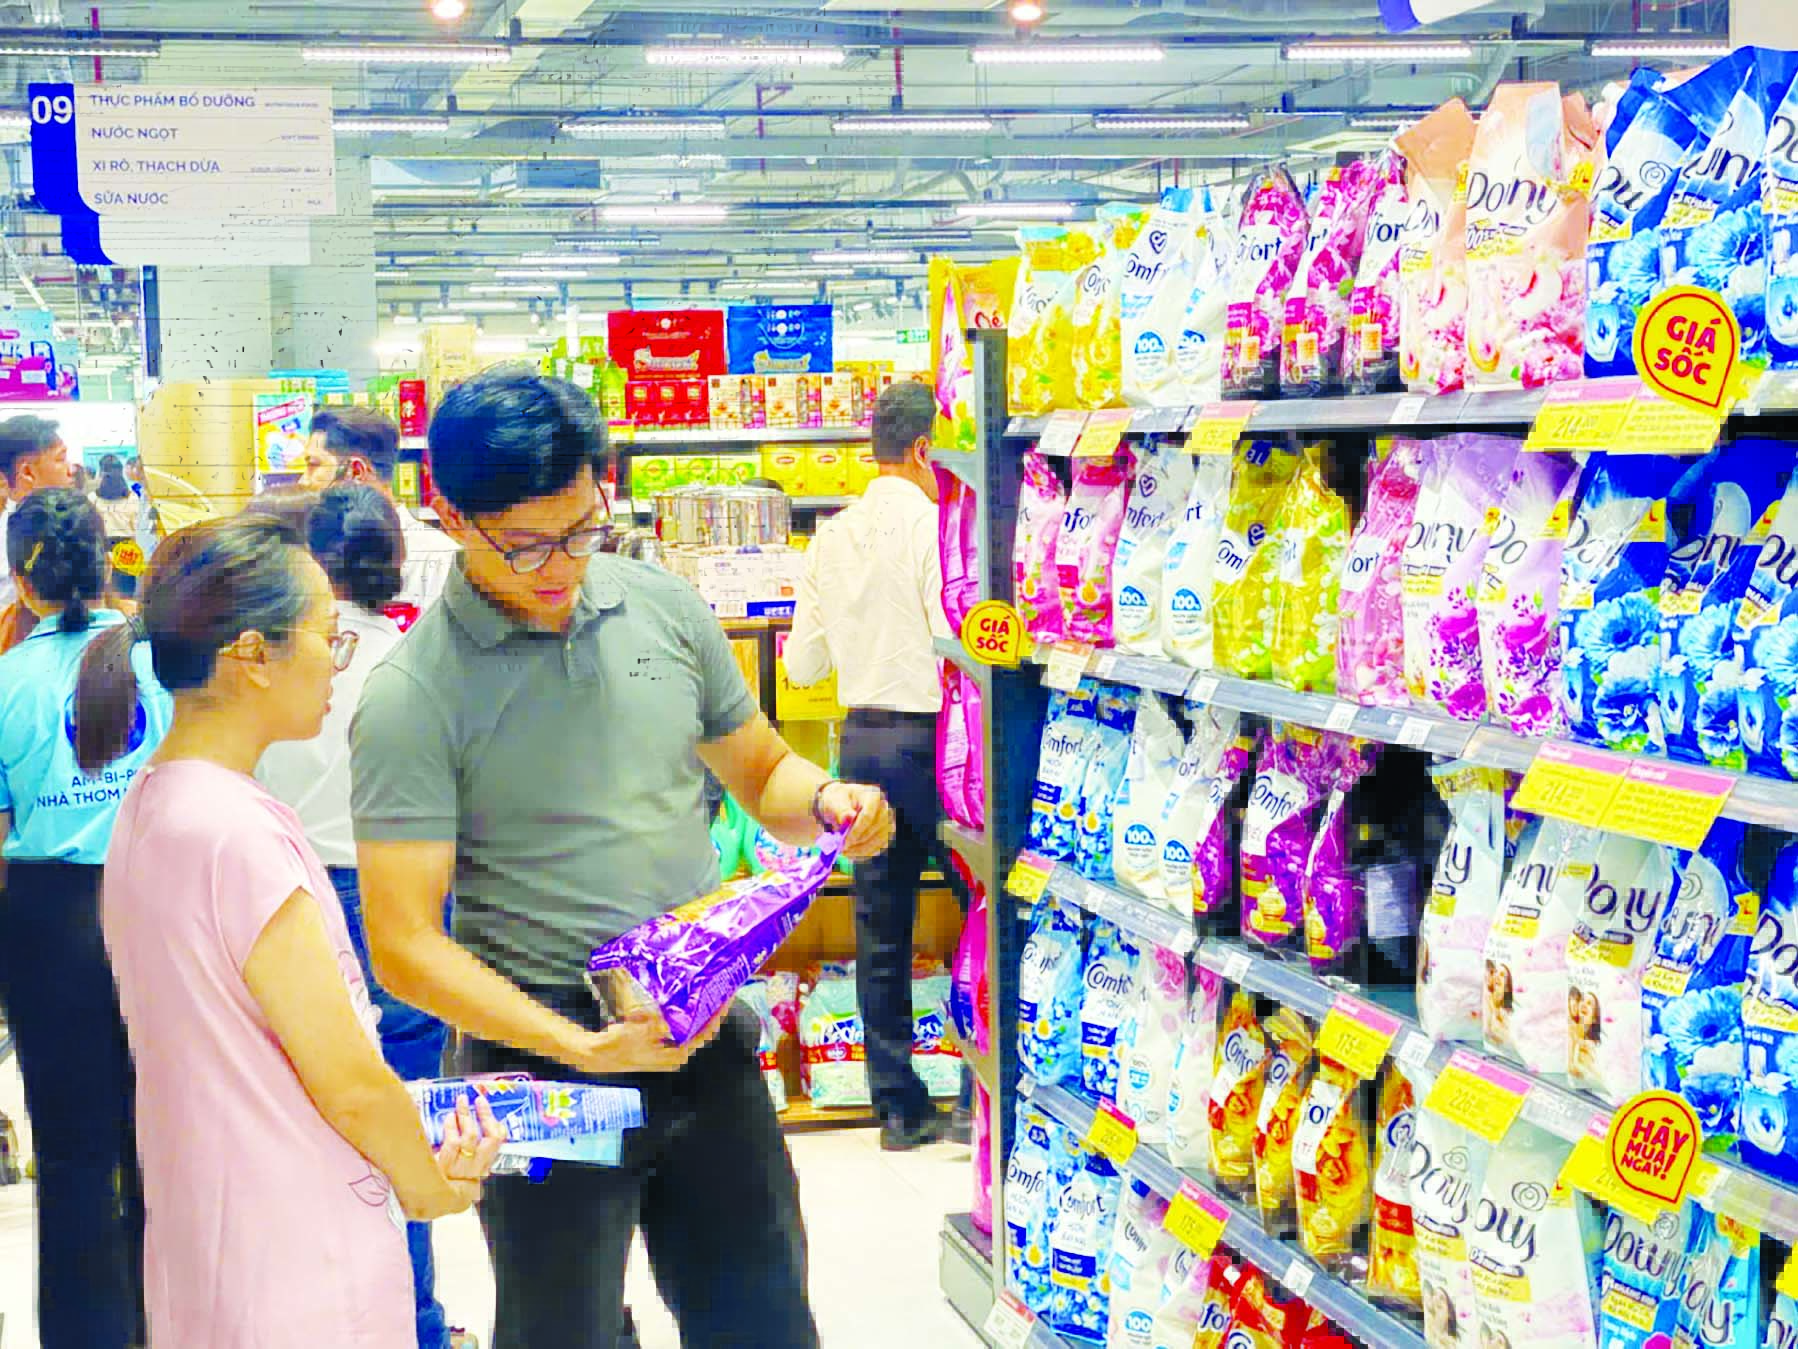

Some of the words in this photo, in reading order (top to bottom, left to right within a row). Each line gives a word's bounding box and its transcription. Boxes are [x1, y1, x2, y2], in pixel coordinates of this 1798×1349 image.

[31, 96, 73, 124] 09
[137, 127, 178, 142] NGỌT
[93, 160, 106, 172] XI
[1666, 316, 1721, 354] GIÁ
[1654, 347, 1712, 385] SỐC
[979, 615, 1011, 636] GIÁ
[975, 633, 1009, 653] SỐC
[72, 768, 138, 788] AM-BI-P
[36, 791, 69, 808] NHÀ
[73, 788, 120, 804] THƠM
[1631, 1117, 1690, 1154] HÃY
[1626, 1139, 1666, 1163] MUA
